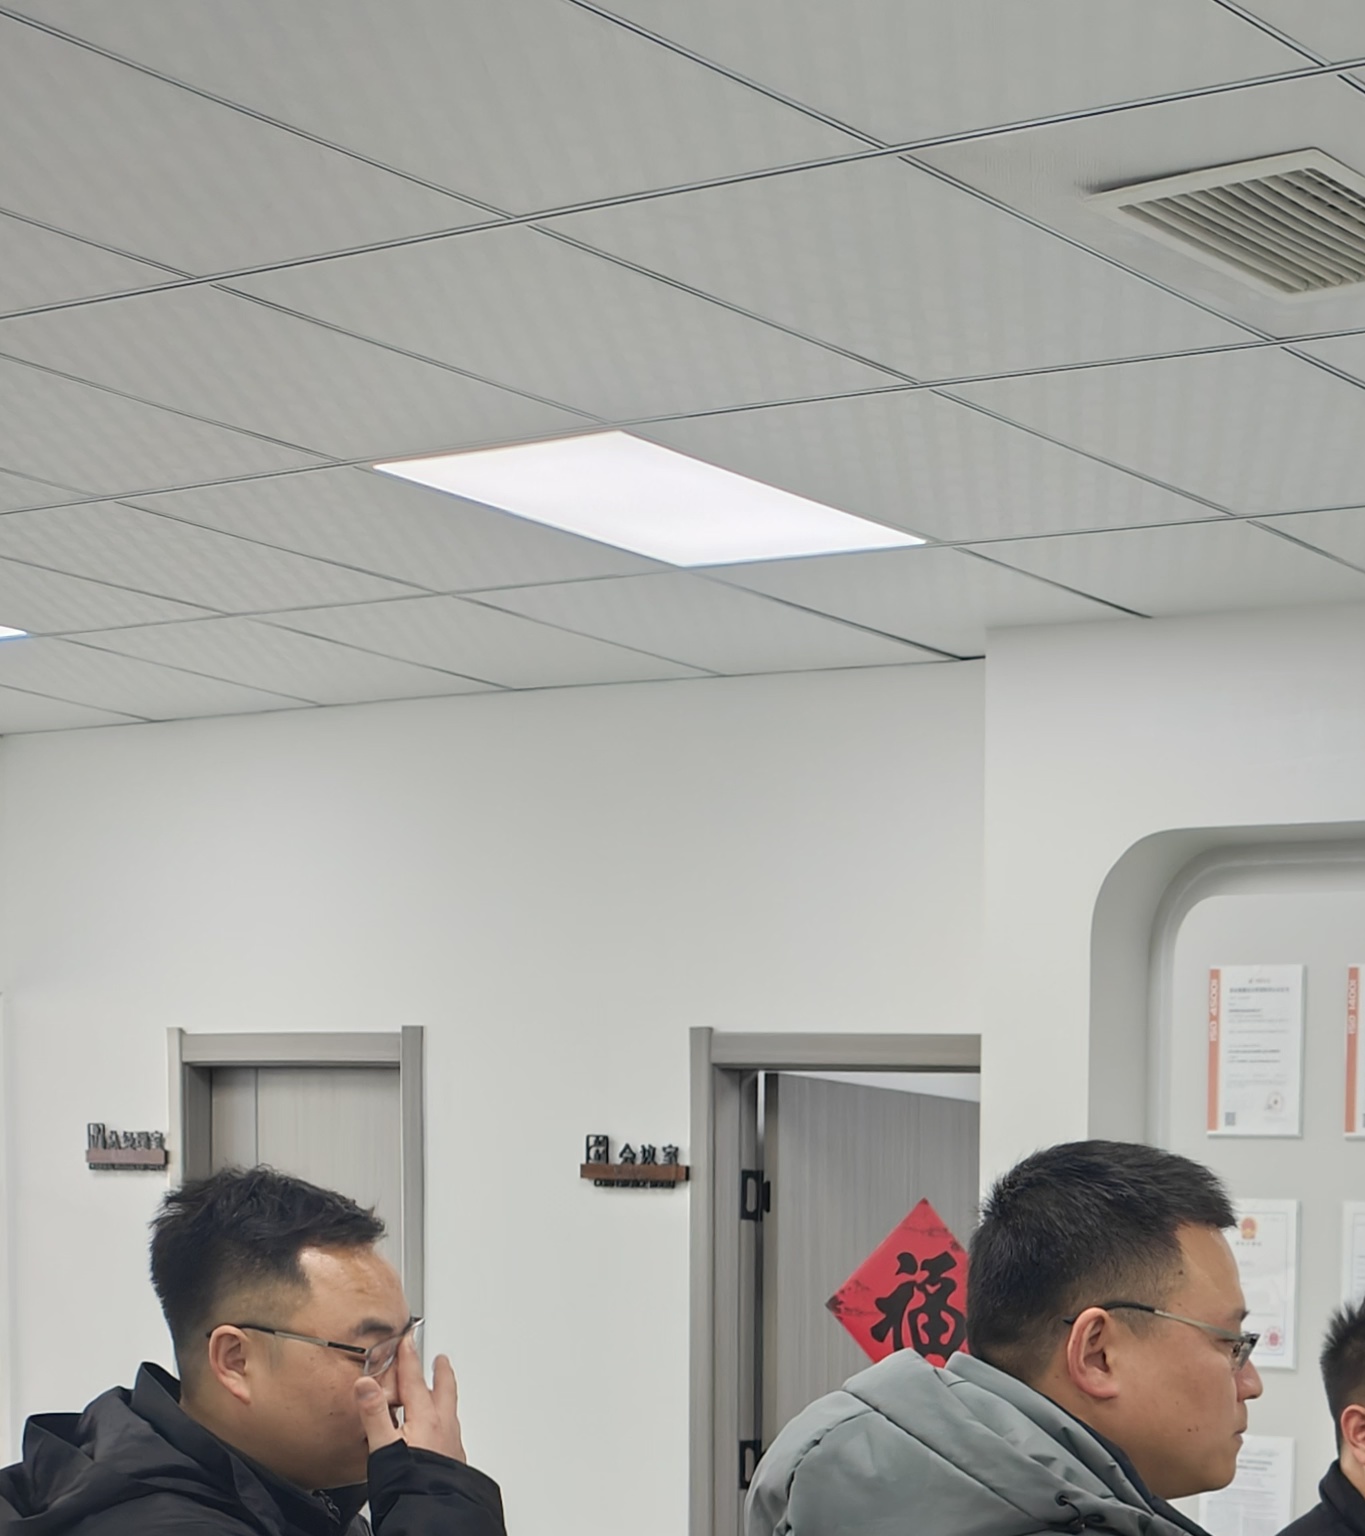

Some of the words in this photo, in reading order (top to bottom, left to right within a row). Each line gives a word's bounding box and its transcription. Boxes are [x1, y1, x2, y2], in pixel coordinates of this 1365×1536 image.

[618, 1142, 680, 1165] 会议室
[869, 1251, 967, 1364] 福
